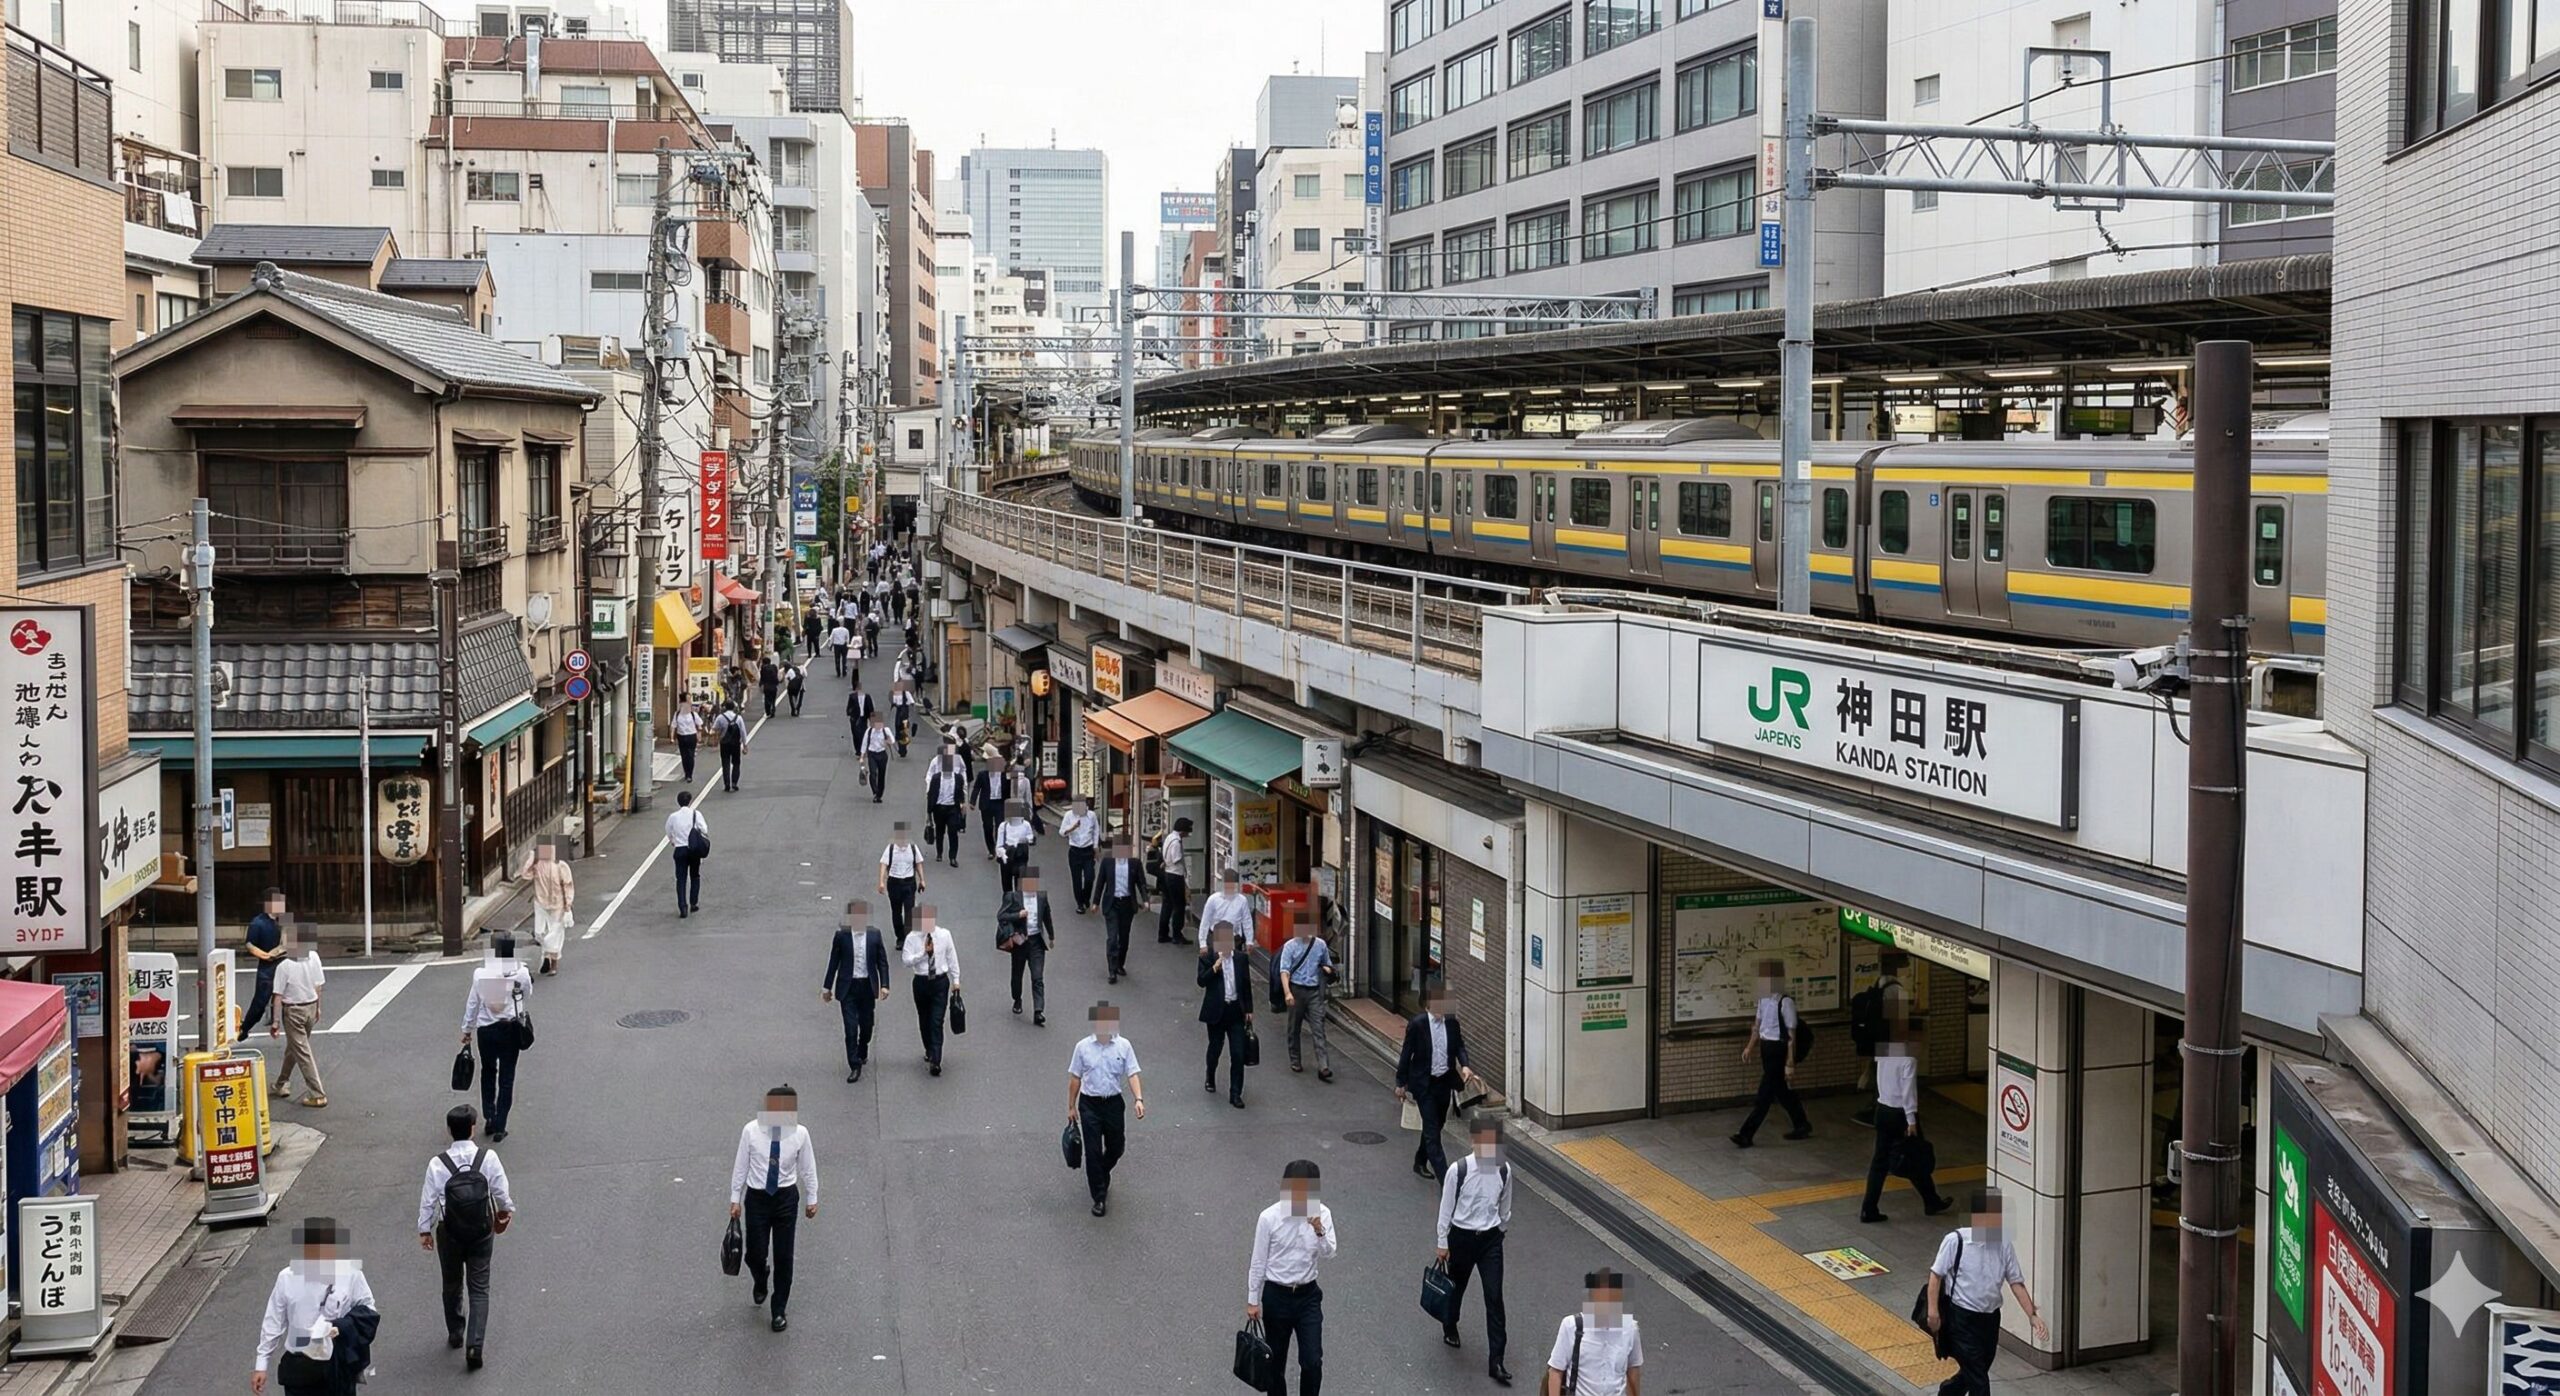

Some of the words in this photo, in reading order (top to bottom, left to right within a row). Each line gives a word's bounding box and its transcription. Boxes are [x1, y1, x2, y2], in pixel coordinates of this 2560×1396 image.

[1748, 667, 1811, 730] JR
[1836, 677, 1988, 760] 神田駅
[1836, 741, 1899, 775] KANDA
[1905, 756, 1987, 797] STATION
[40, 1215, 66, 1308] うどんぼ
